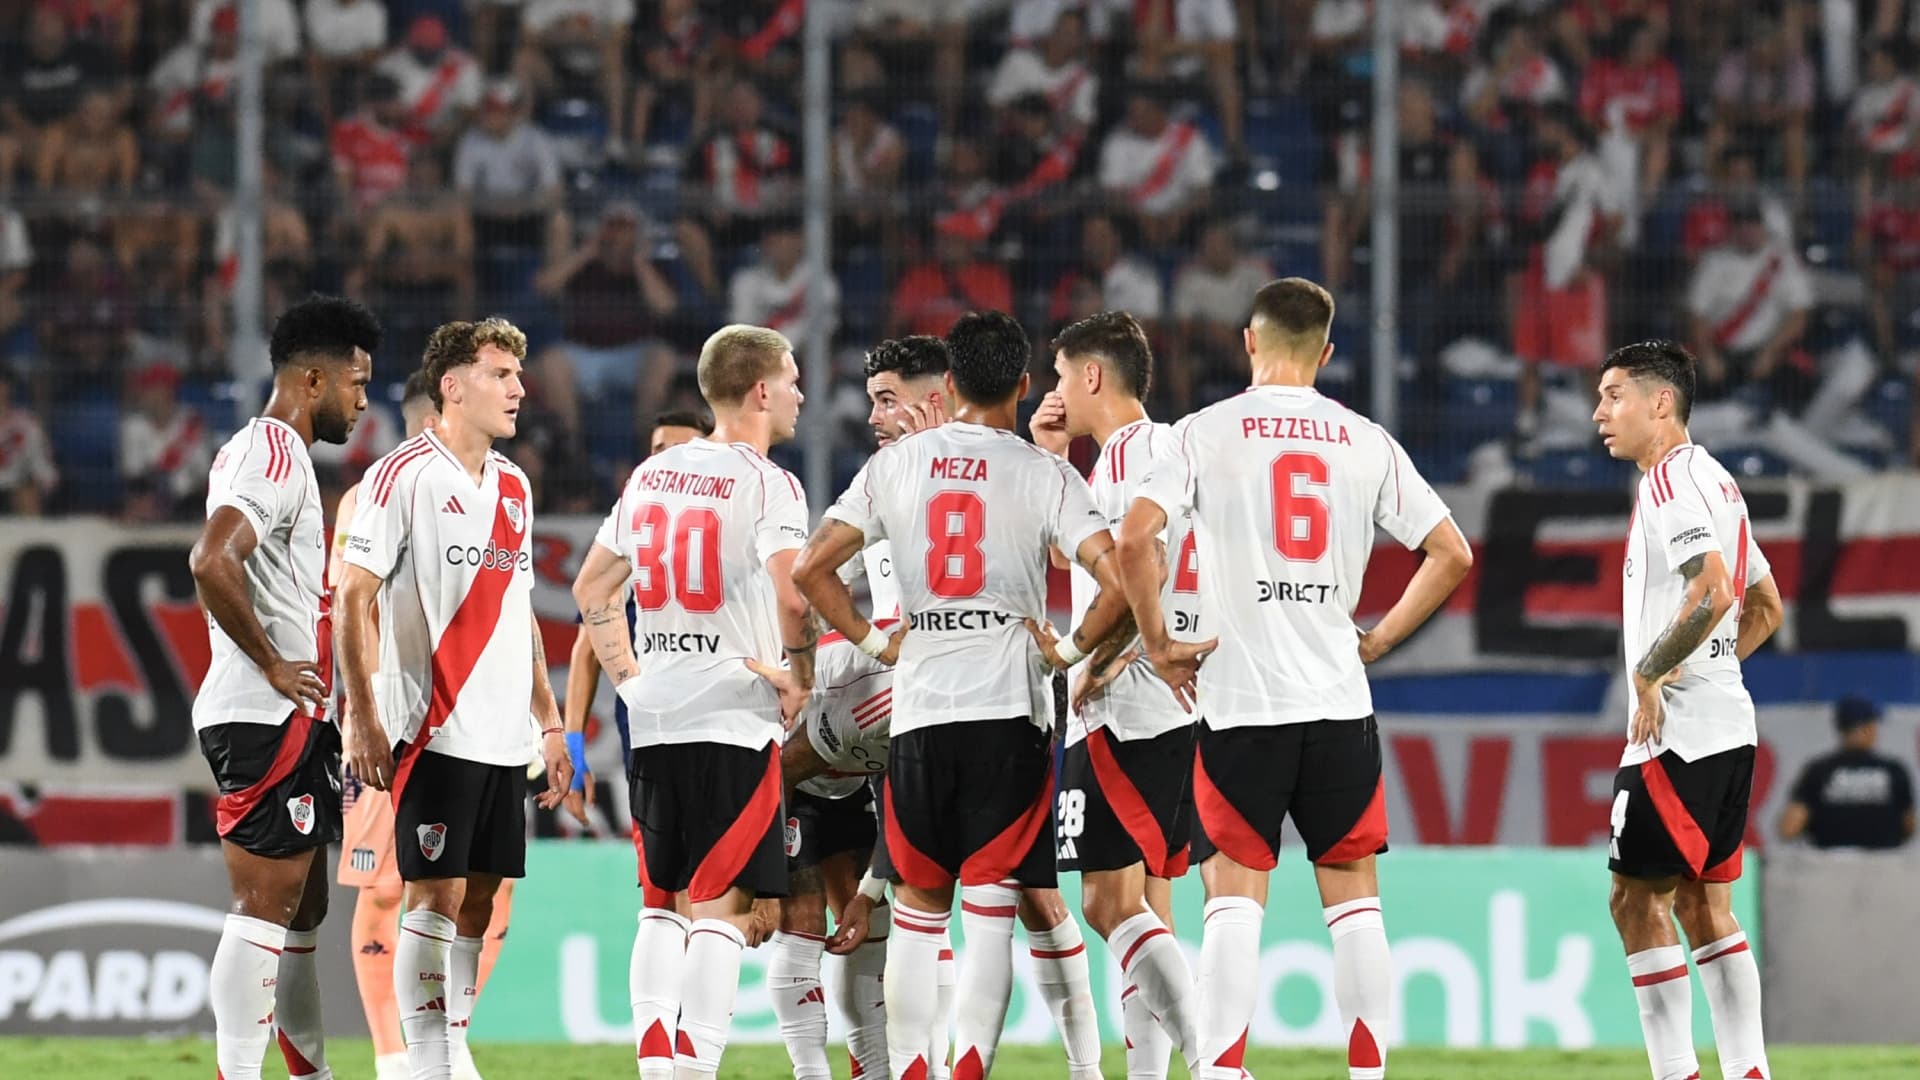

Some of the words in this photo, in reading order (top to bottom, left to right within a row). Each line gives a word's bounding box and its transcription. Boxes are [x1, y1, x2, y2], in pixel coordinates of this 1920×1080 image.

[1241, 416, 1352, 446] PEZZELLA
[637, 469, 735, 500] MASTANTUONO
[930, 456, 988, 481] MEZA
[1269, 450, 1331, 564] 6
[446, 540, 529, 572] codere
[631, 501, 723, 614] 30
[925, 489, 986, 599] 8
[643, 632, 720, 655] DIRECTV
[1057, 788, 1086, 838] 28
